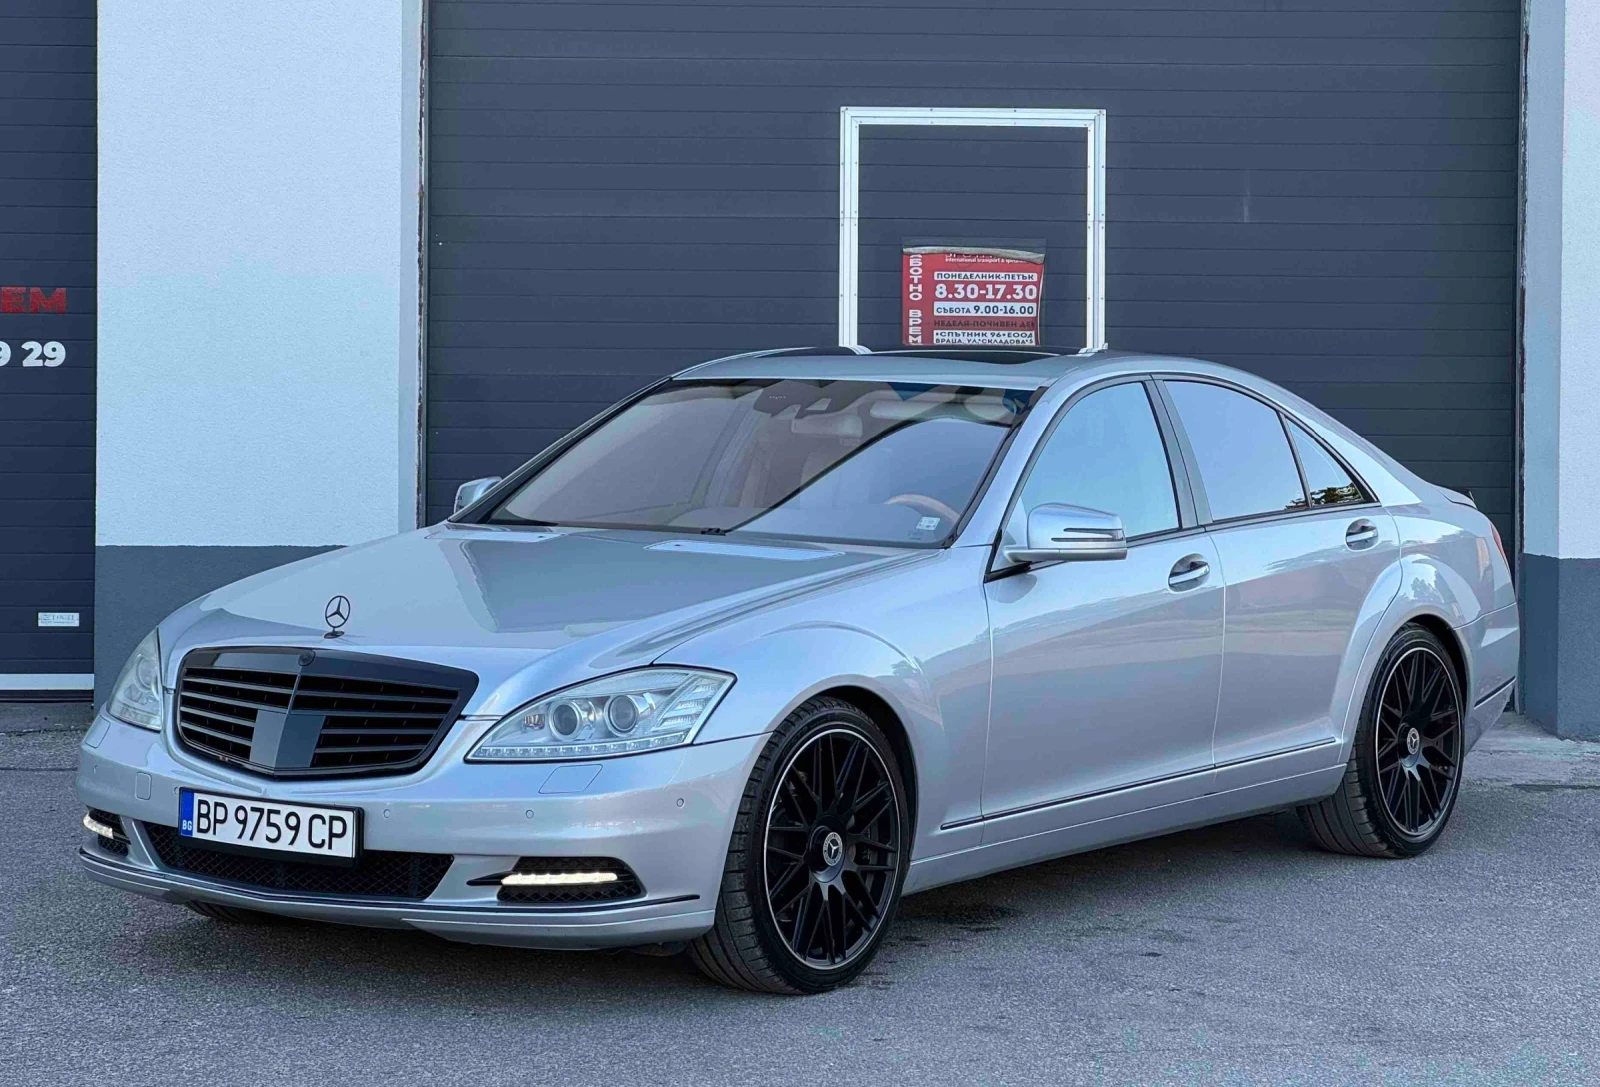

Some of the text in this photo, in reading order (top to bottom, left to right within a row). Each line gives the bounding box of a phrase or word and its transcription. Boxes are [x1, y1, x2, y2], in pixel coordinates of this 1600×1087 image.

[936, 272, 1034, 281] ПОНЕДЕЛНИК-ПЕТЪК
[935, 283, 1038, 299] 8.30-17.30
[973, 305, 1034, 315] 9.00-16.00
[21, 341, 66, 368] 29
[182, 819, 193, 831] BG
[197, 799, 347, 850] BP 9759 CP
